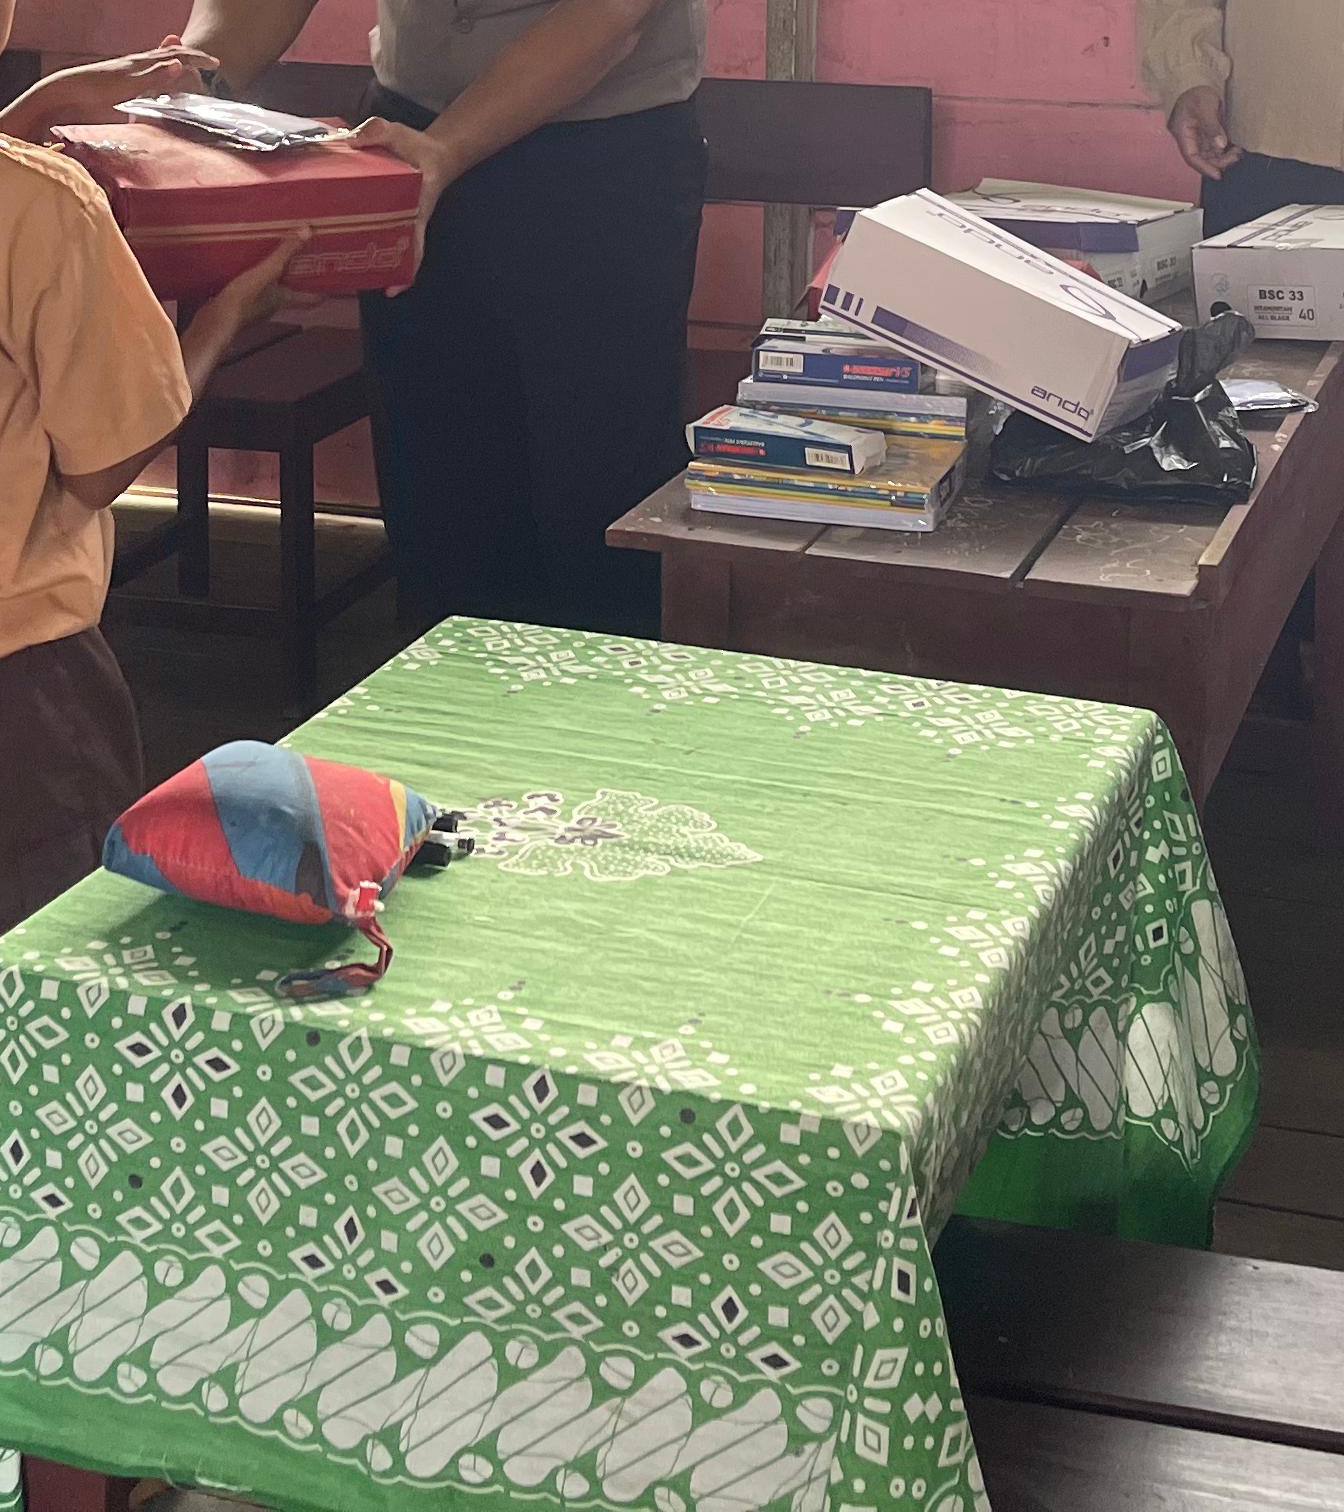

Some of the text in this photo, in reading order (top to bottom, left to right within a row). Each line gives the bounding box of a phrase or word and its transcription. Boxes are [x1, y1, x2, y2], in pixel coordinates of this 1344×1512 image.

[1258, 289, 1305, 301] BSC 33
[1298, 308, 1315, 321] 40
